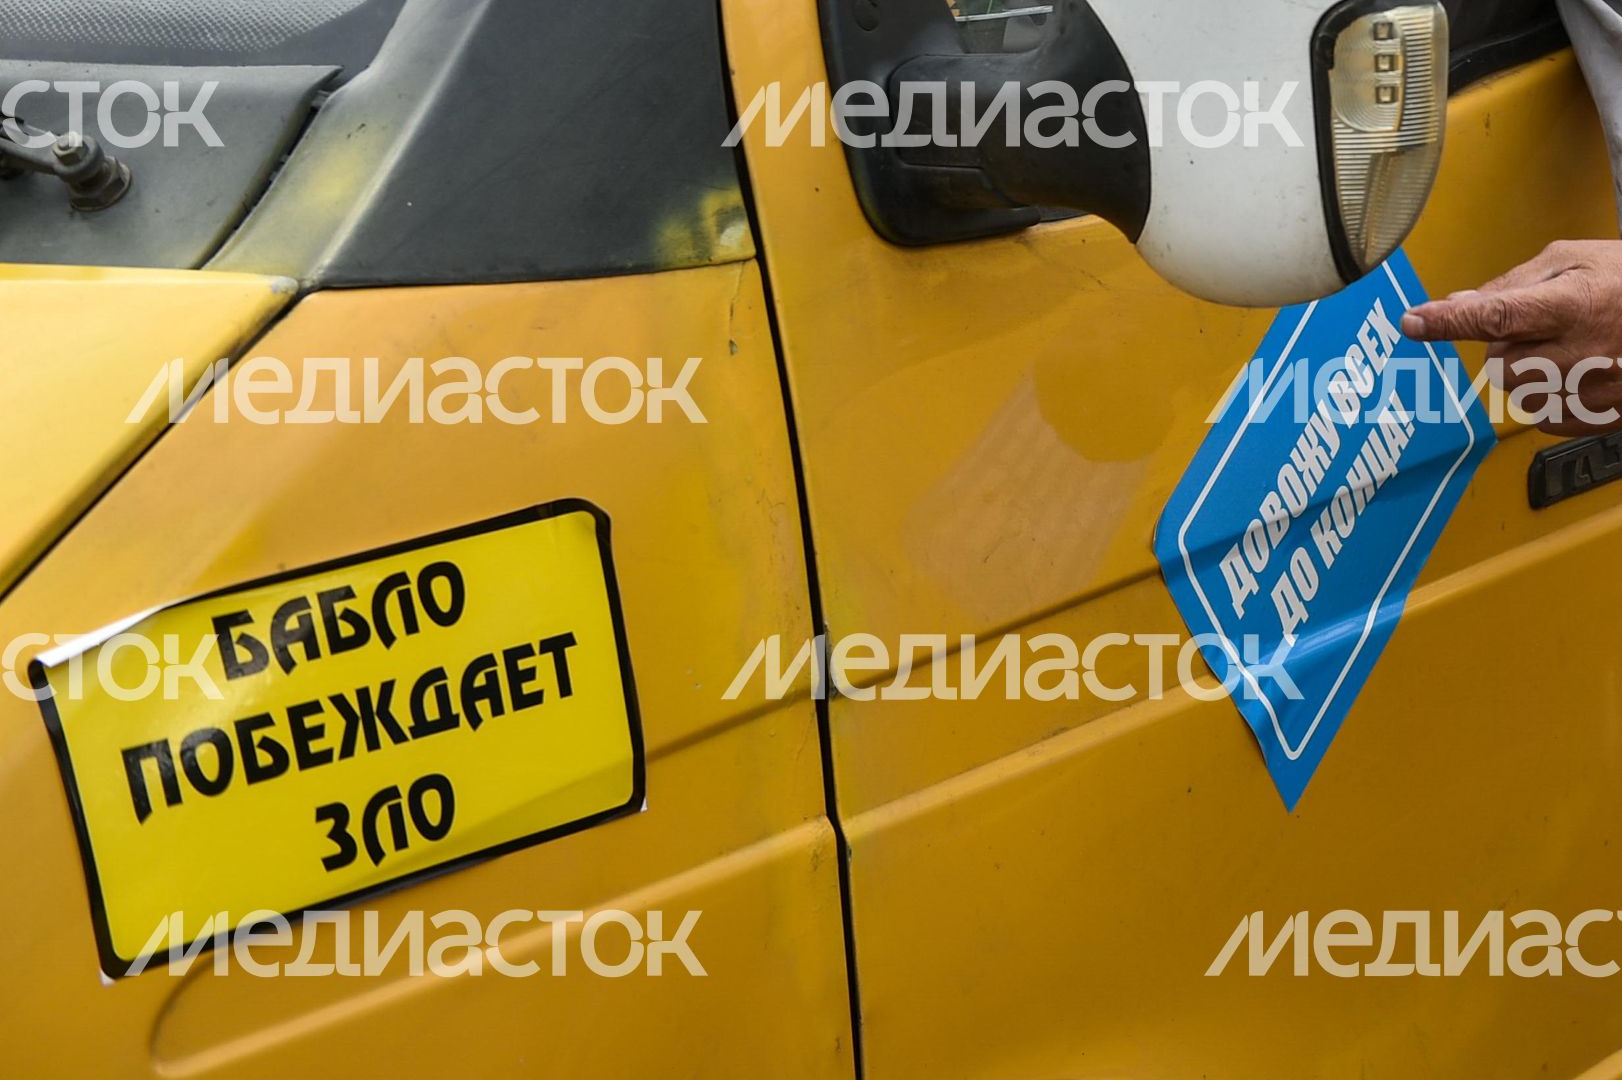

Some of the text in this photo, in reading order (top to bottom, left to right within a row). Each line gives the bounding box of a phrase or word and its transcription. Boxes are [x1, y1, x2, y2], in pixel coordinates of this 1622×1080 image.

[1219, 297, 1402, 619] ДОВОЖУ ВСЕХ
[1270, 392, 1416, 647] ДО КОНЦА!
[211, 561, 466, 681] БАБЛО
[121, 632, 577, 824] ПОБЕЖДАЕТ
[315, 774, 456, 872] ЗЛО
